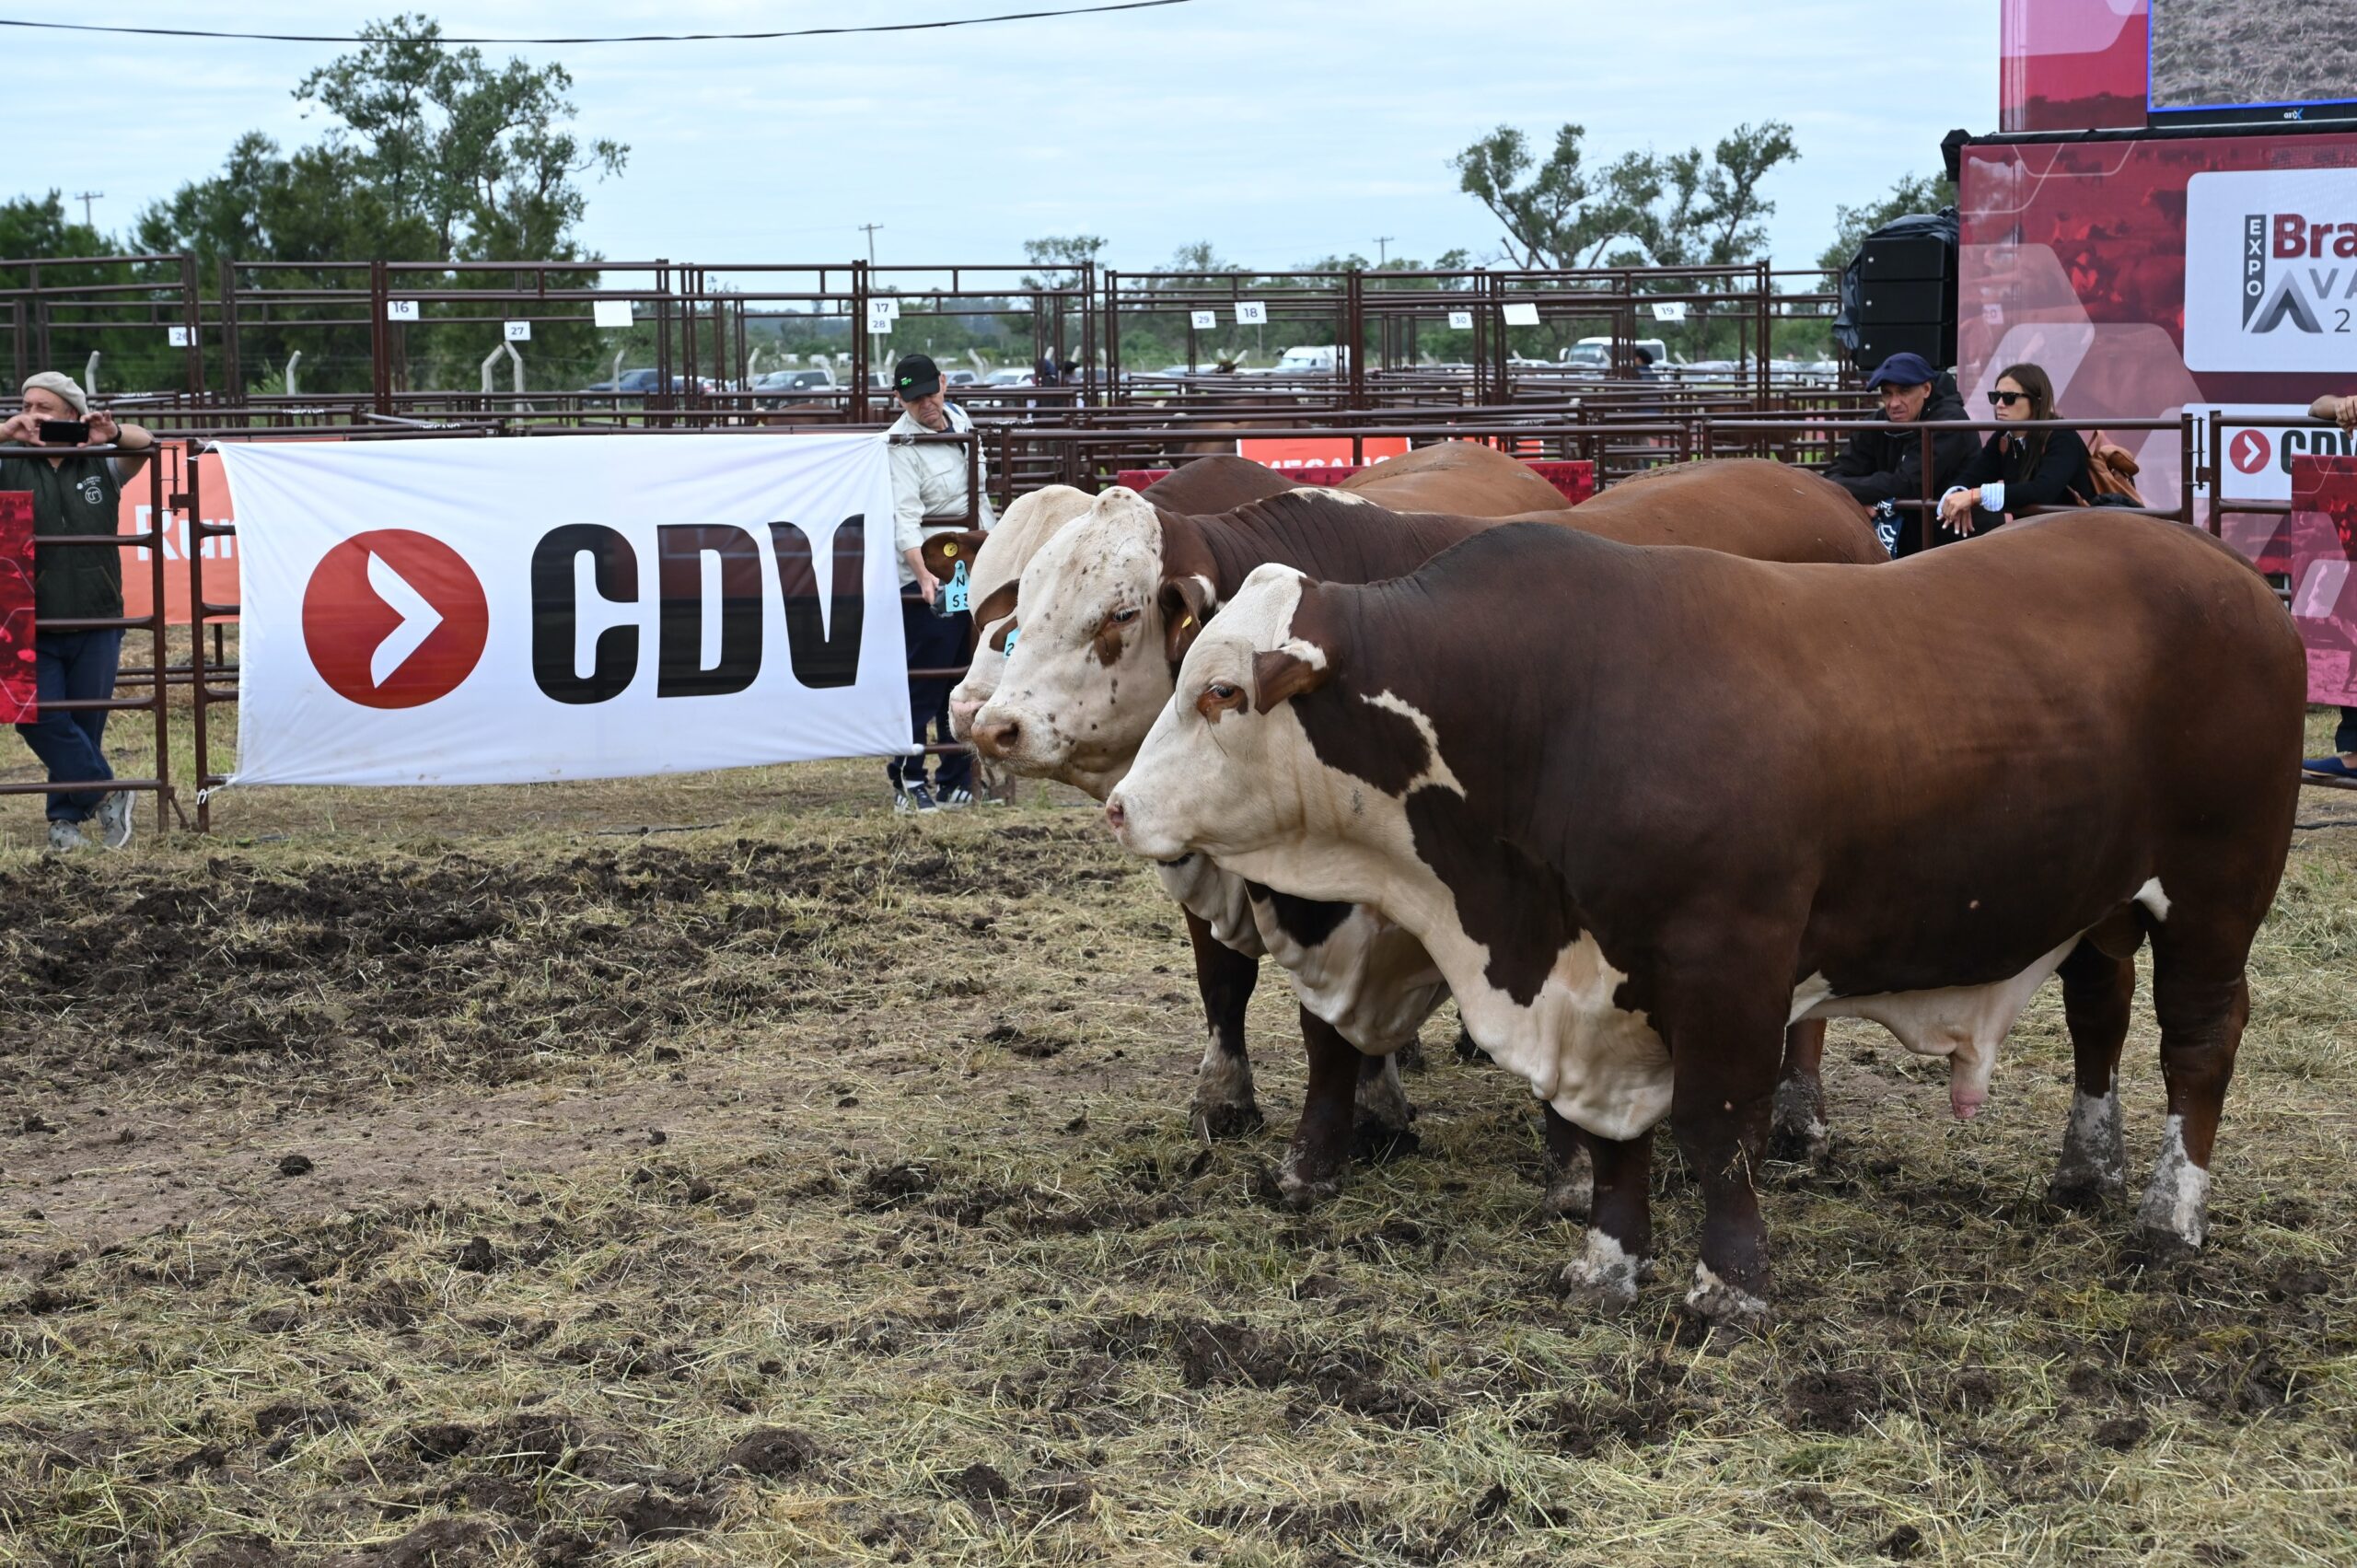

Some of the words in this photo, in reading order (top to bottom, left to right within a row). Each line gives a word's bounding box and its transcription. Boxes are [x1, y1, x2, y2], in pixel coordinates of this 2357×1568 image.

[2247, 219, 2262, 296] EXPO
[393, 301, 410, 313] 16
[875, 303, 889, 313] 17
[1661, 307, 1674, 316] 19
[1243, 308, 1259, 318] 18
[872, 319, 886, 329] 28
[1198, 316, 1210, 324] 29
[510, 327, 524, 335] 27
[957, 575, 965, 587] N
[530, 513, 865, 705] CDV
